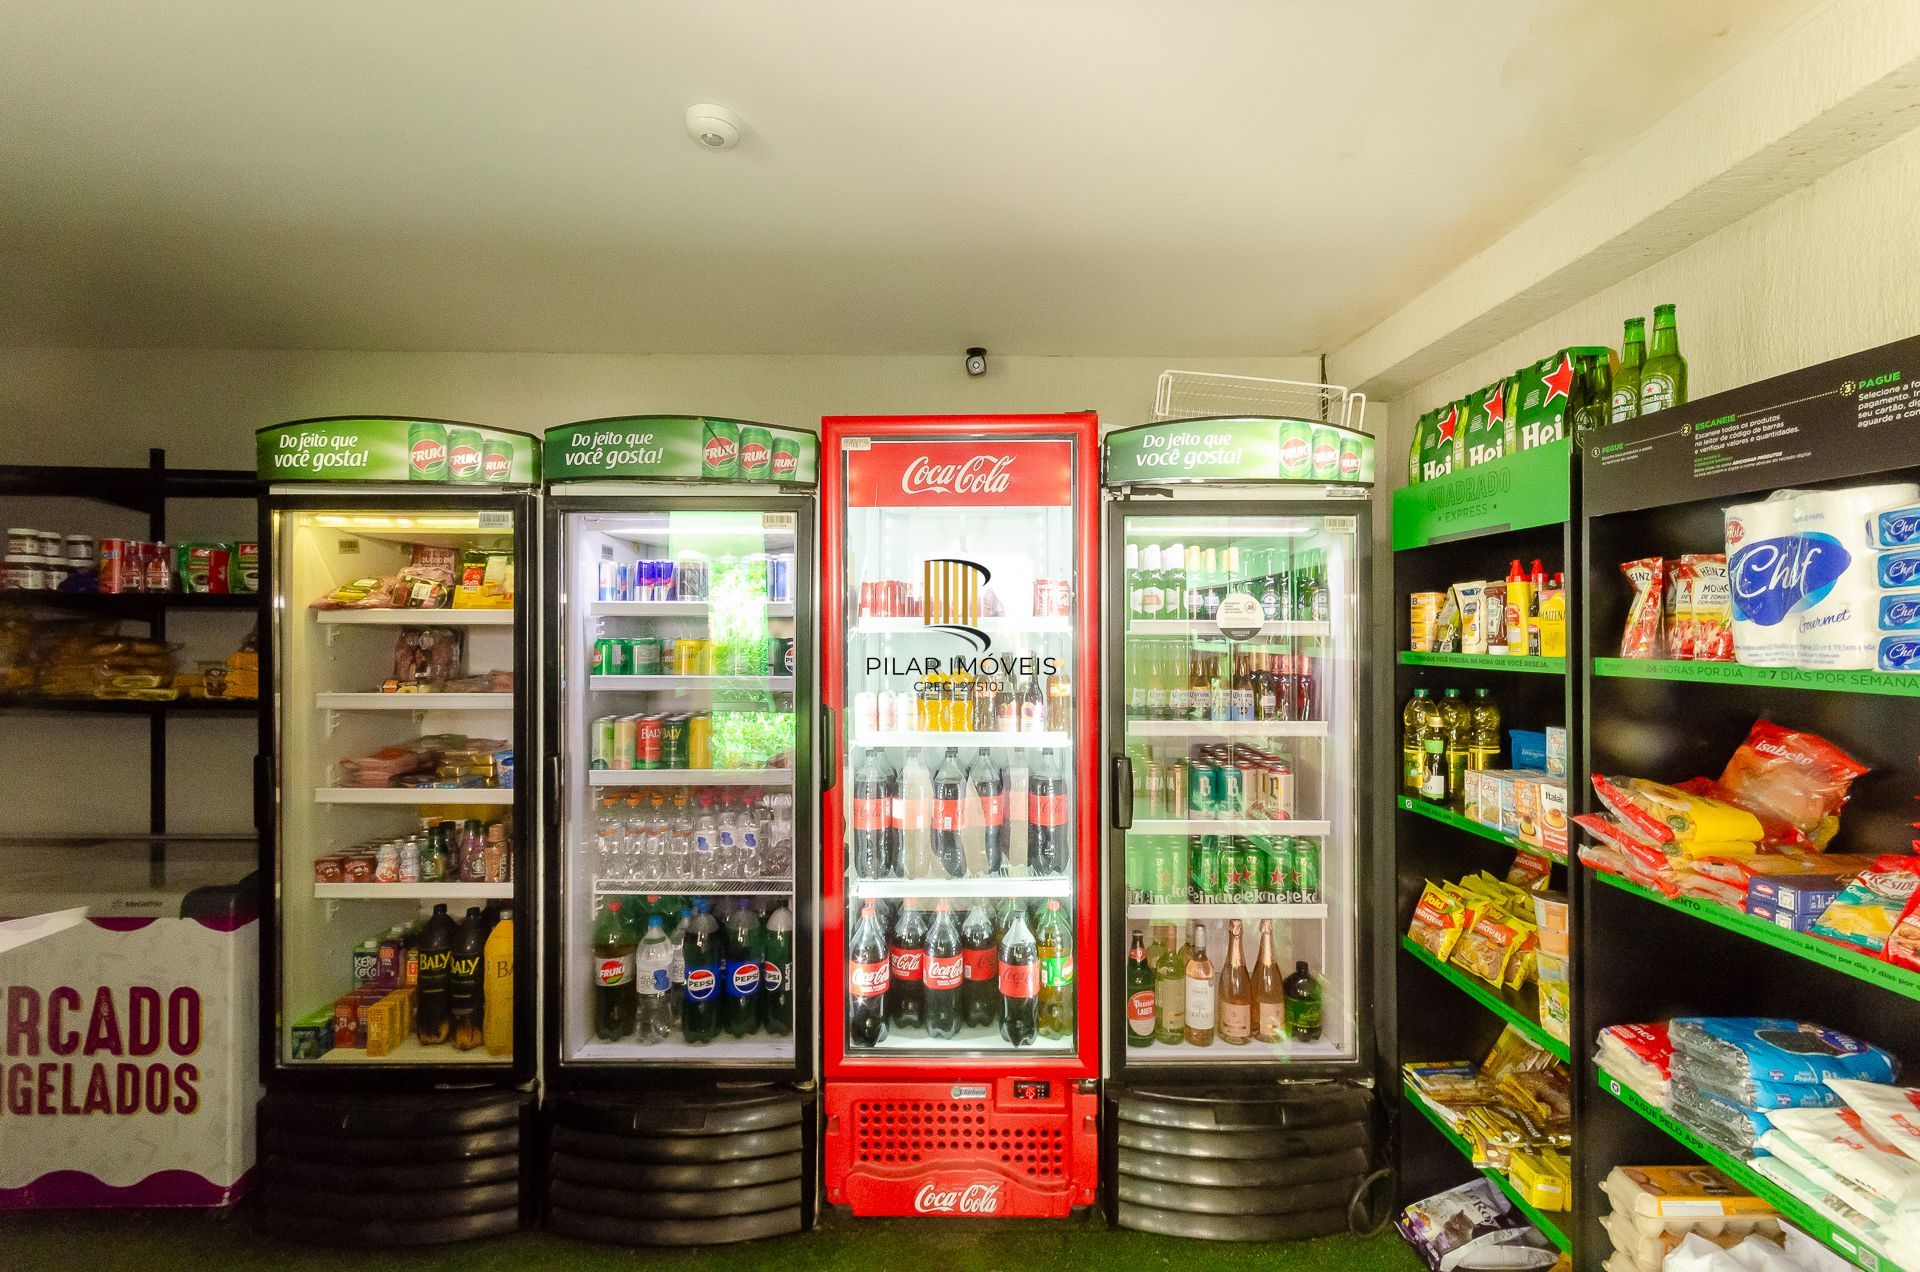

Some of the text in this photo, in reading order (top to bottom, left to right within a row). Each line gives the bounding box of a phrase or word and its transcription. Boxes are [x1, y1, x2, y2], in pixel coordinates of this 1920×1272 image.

[1858, 371, 1901, 390] PAGUE
[1858, 386, 1901, 401] Selecione
[1858, 393, 1911, 411] pagamento.
[1858, 411, 1873, 419] seu
[1875, 403, 1906, 415] cartão,
[1694, 429, 1721, 440] Escaneie
[1721, 424, 1740, 434] todos
[1750, 414, 1781, 428] produtos
[1695, 414, 1736, 431] ESCANEIE
[1858, 414, 1894, 428] aguarde
[280, 430, 358, 451] Do jeito que
[572, 431, 654, 448] Do jeito que
[1142, 432, 1232, 450] Do jeito que
[1700, 444, 1726, 454] verifique
[1726, 437, 1749, 448] valores
[1756, 426, 1800, 441] quantidades.
[1703, 436, 1719, 445] leitor
[1729, 428, 1752, 440] código
[1762, 422, 1785, 432] barras
[410, 446, 446, 460] FRUKI
[565, 448, 664, 469] você gosta!
[703, 443, 738, 460] FRUKI
[742, 448, 771, 462] FRUKI
[1136, 448, 1244, 468] você gosta!
[274, 450, 368, 472] você gosta!
[901, 454, 1018, 494] Coca-Cola
[1428, 467, 1511, 512] QUADRADO
[1445, 506, 1488, 521] EXPRESS
[1699, 566, 1726, 577] HEINZ
[1658, 667, 1695, 676] HORAS
[1697, 667, 1720, 677] POR
[1723, 668, 1743, 678] DIA
[1770, 670, 1919, 688] 7 DIAS POR SEMANA
[420, 952, 452, 970] BALY
[1804, 943, 1814, 952] 24
[1816, 946, 1836, 960] horas
[1838, 954, 1852, 964] por
[1870, 964, 1876, 973] 7
[1878, 968, 1896, 981] dias
[1898, 976, 1914, 988] por
[600, 966, 625, 978] FRUKI
[735, 972, 760, 982] PEPSI
[784, 963, 792, 992] BLACK
[688, 979, 714, 988] PEPSI
[0, 986, 202, 1056] RCADO
[1628, 1095, 1704, 1149] PAGUE PELO APP
[914, 1184, 1000, 1212] Coca-Cola
